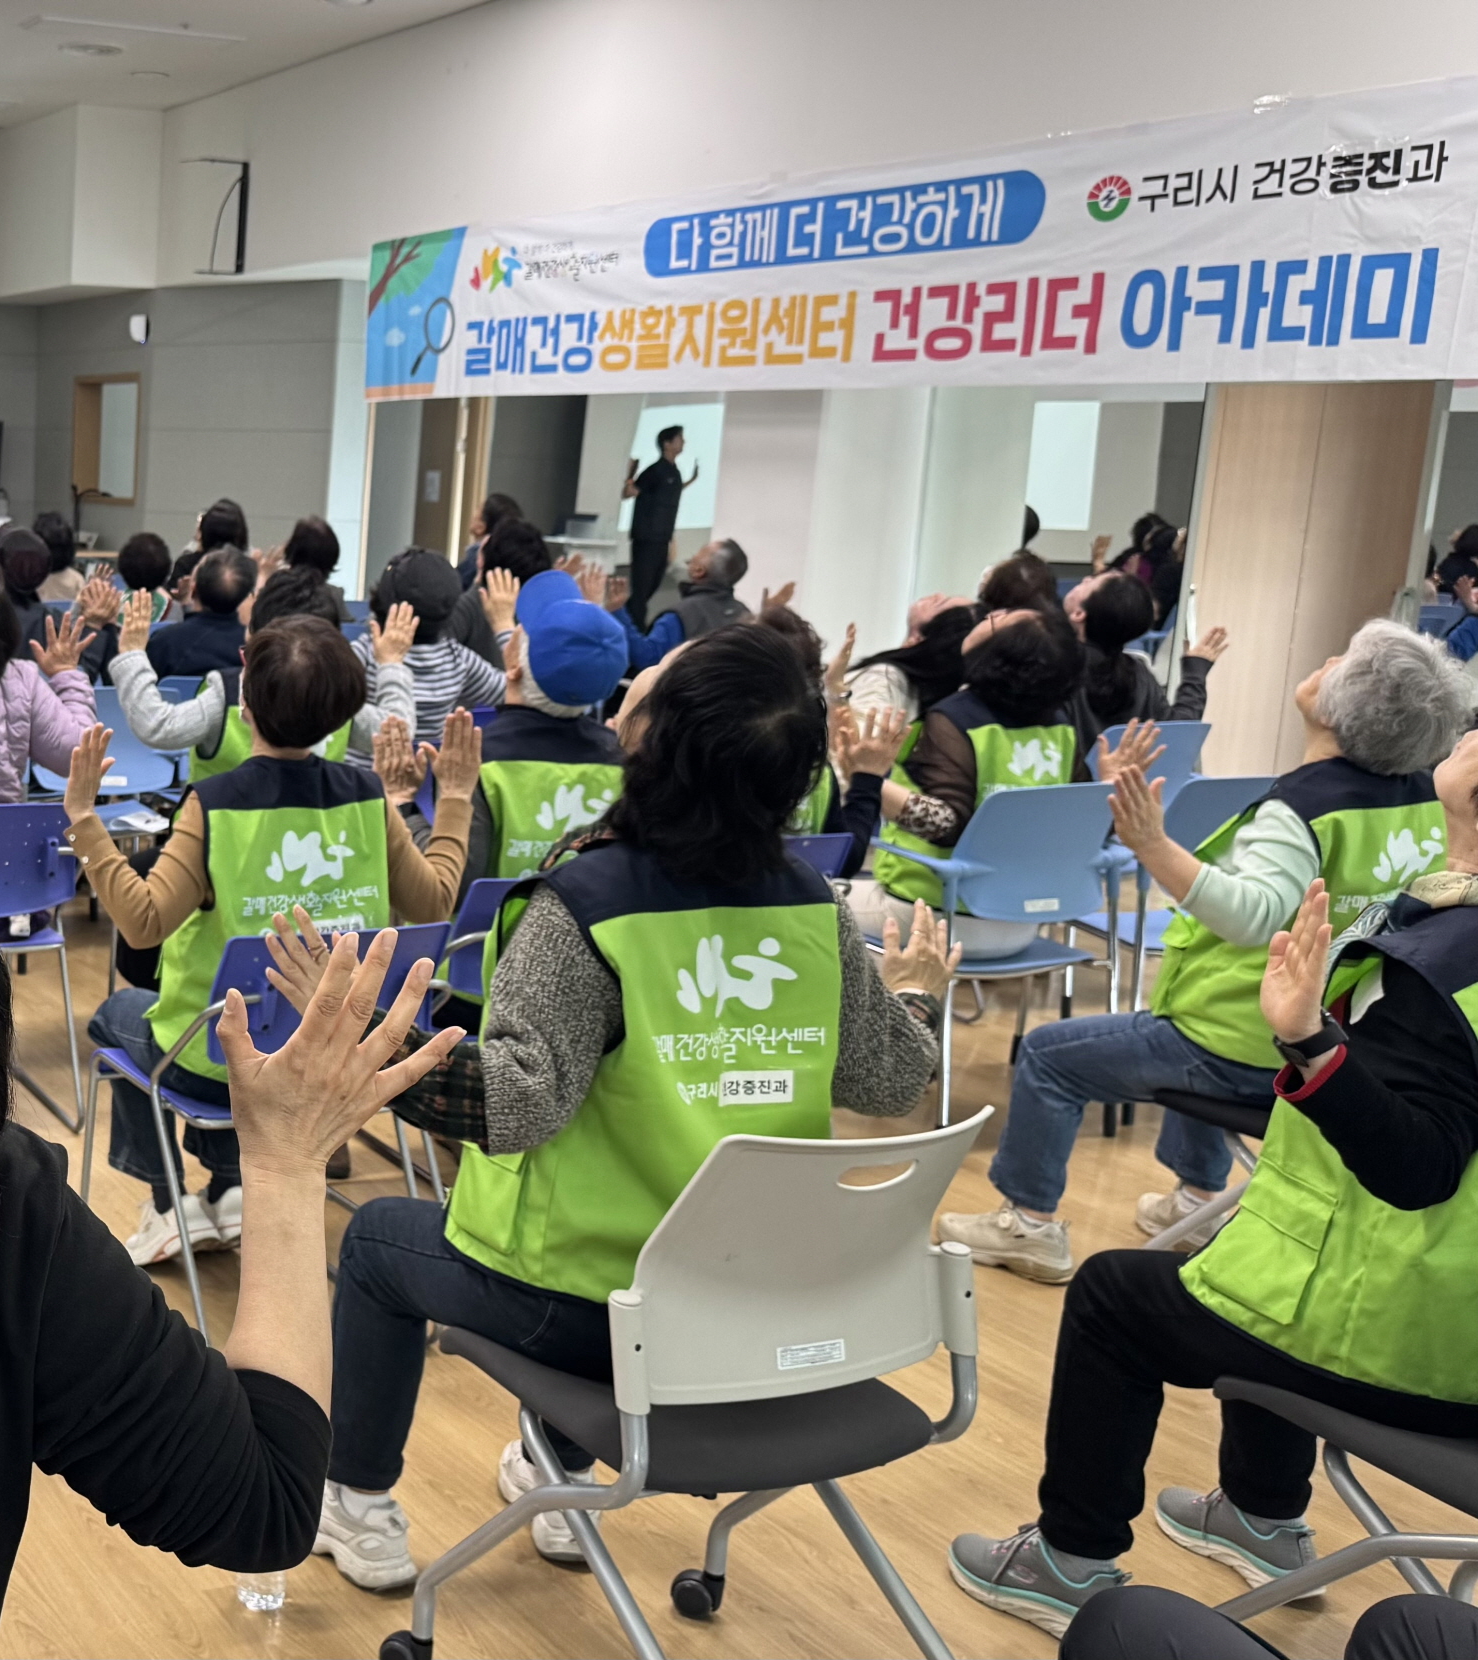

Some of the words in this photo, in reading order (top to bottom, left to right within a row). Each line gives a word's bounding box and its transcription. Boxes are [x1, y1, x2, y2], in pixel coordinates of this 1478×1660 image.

[1137, 164, 1239, 213] 구리시
[1251, 140, 1449, 202] 건강증진과
[785, 201, 825, 259] 더
[834, 178, 1005, 257] 건강하게
[463, 290, 858, 378] 갈매건강생활지원센터
[871, 271, 1106, 363] 건강리더
[1120, 247, 1440, 353] 아카데미
